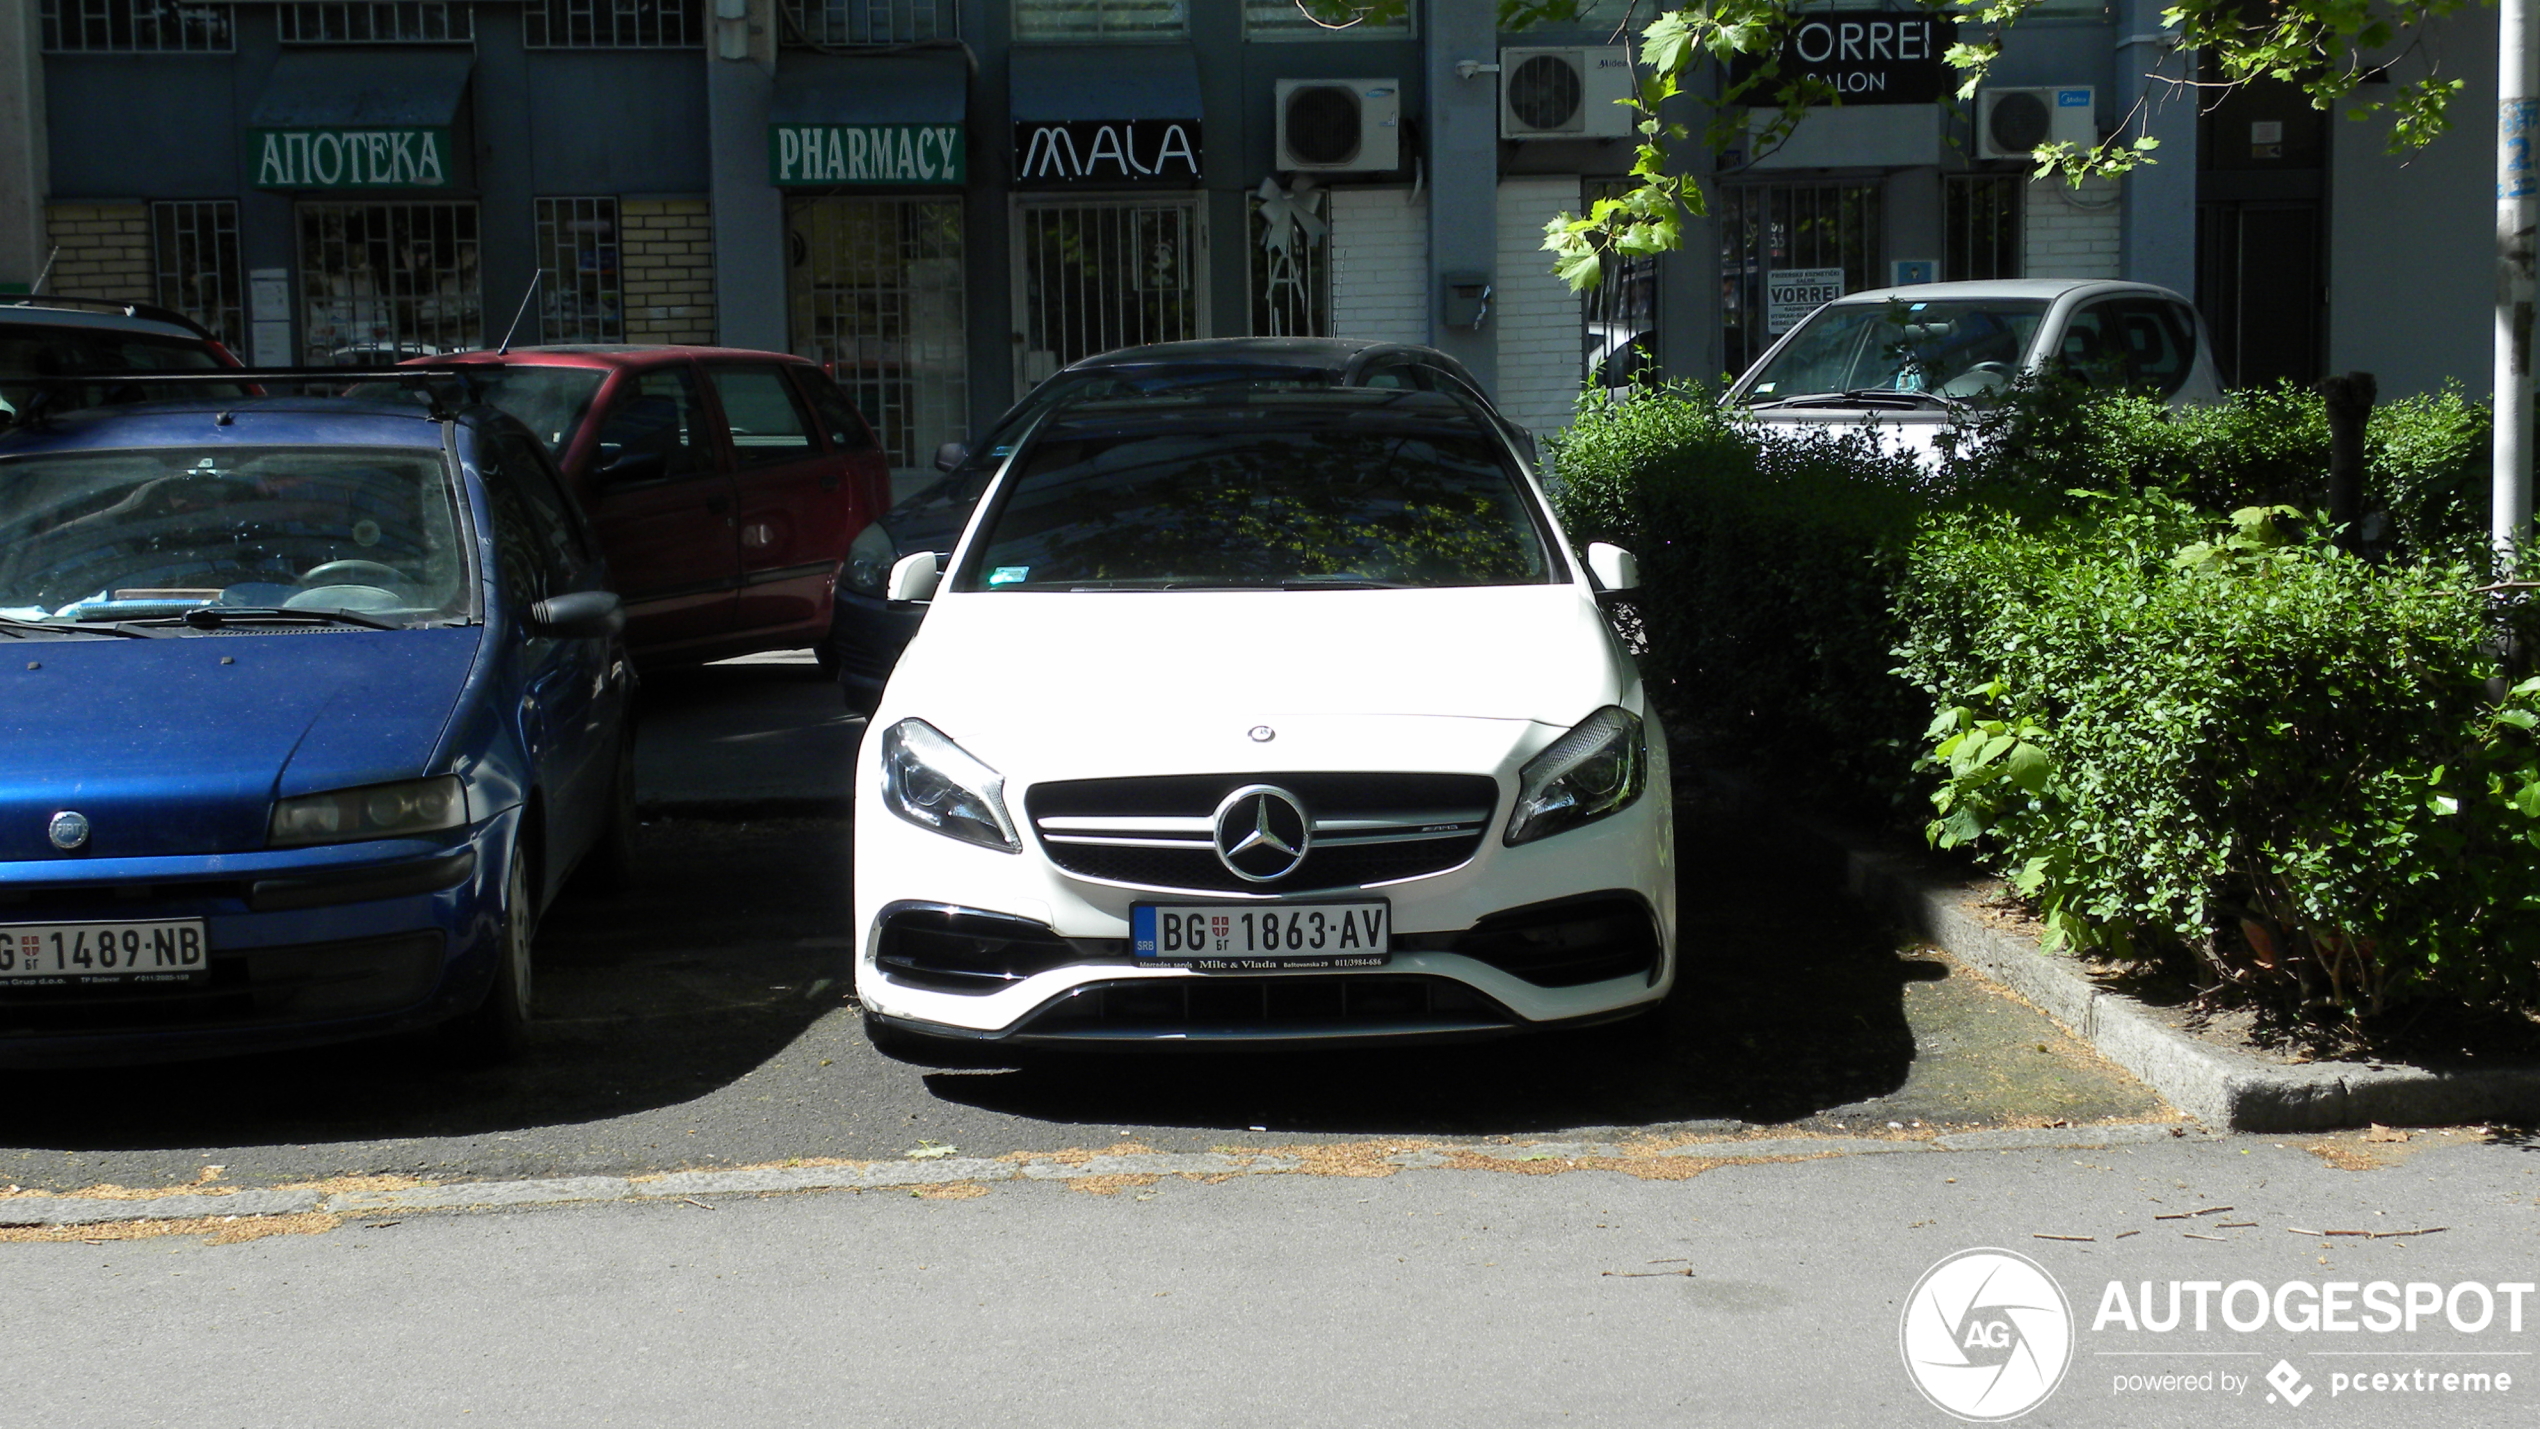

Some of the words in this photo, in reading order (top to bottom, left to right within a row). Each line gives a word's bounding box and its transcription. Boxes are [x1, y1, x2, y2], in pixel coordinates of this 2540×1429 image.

[257, 131, 444, 185] АПОТЕКА
[778, 127, 957, 180] PHARMACY
[1021, 124, 1198, 177] MALA
[1770, 286, 1840, 303] VORREI
[56, 823, 82, 836] FIAT
[1163, 913, 1205, 951] BG
[1137, 940, 1154, 951] SRB
[1199, 960, 1227, 969] Mile
[1230, 961, 1239, 969] &
[1241, 960, 1277, 969] Vlada
[11, 978, 37, 986] Grup
